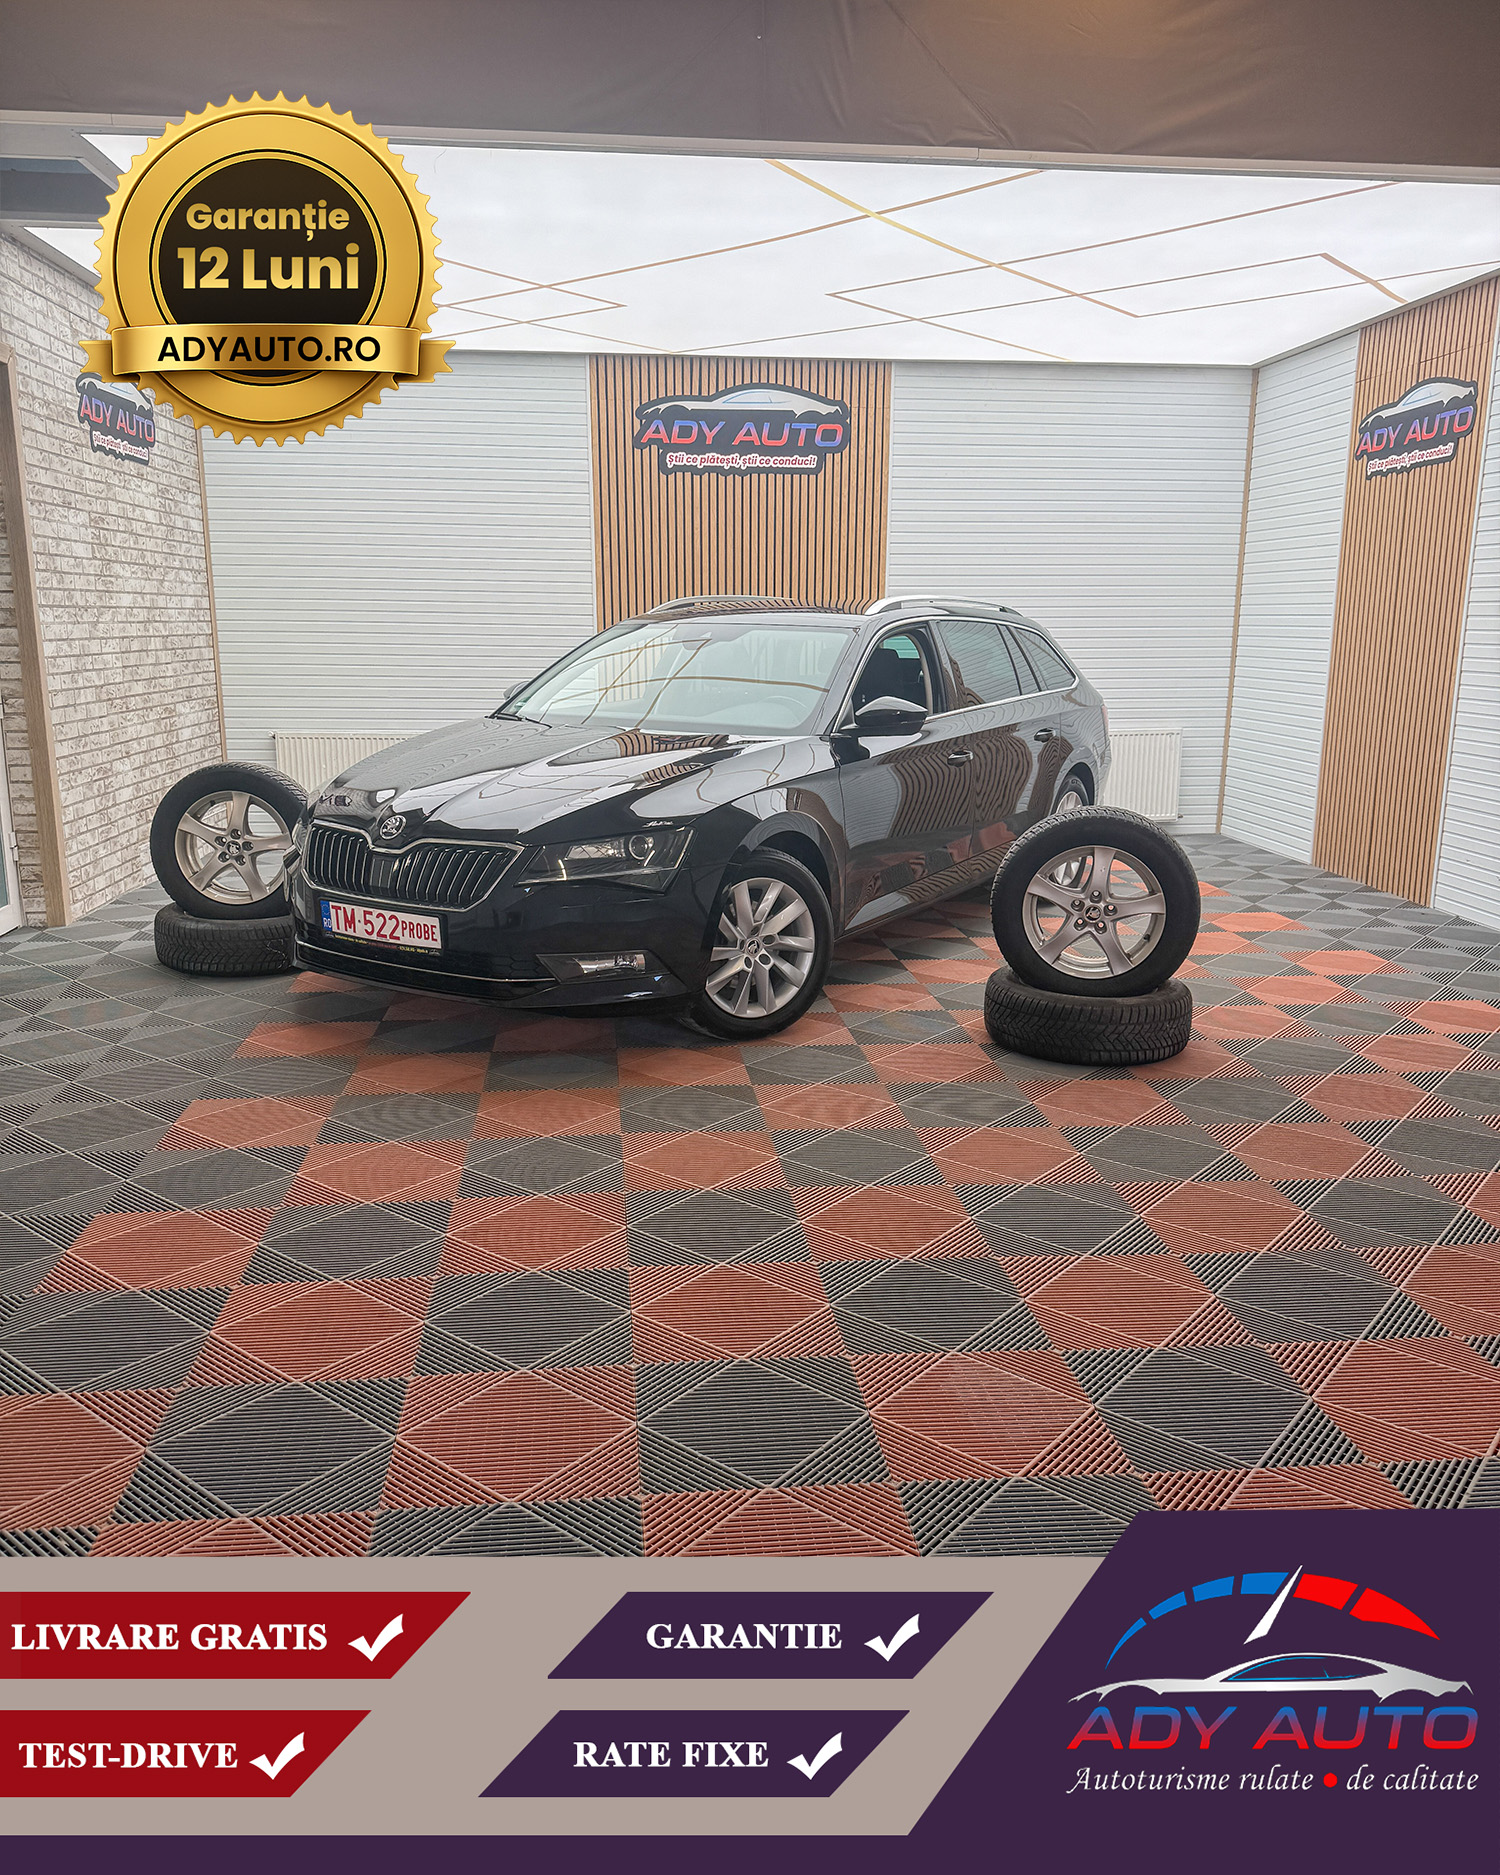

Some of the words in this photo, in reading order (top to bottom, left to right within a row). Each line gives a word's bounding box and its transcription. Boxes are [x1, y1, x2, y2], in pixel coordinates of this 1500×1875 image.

[80, 394, 113, 427] ADY
[116, 408, 154, 443] AUTO
[1356, 423, 1403, 456] ADY
[1403, 405, 1473, 446] AUTO
[640, 419, 726, 445] ADY
[731, 421, 843, 447] AUTO
[668, 454, 685, 467] Știi
[686, 456, 698, 464] ce
[758, 457, 771, 466] ce
[772, 456, 816, 466] conduci!
[323, 917, 332, 929] RO
